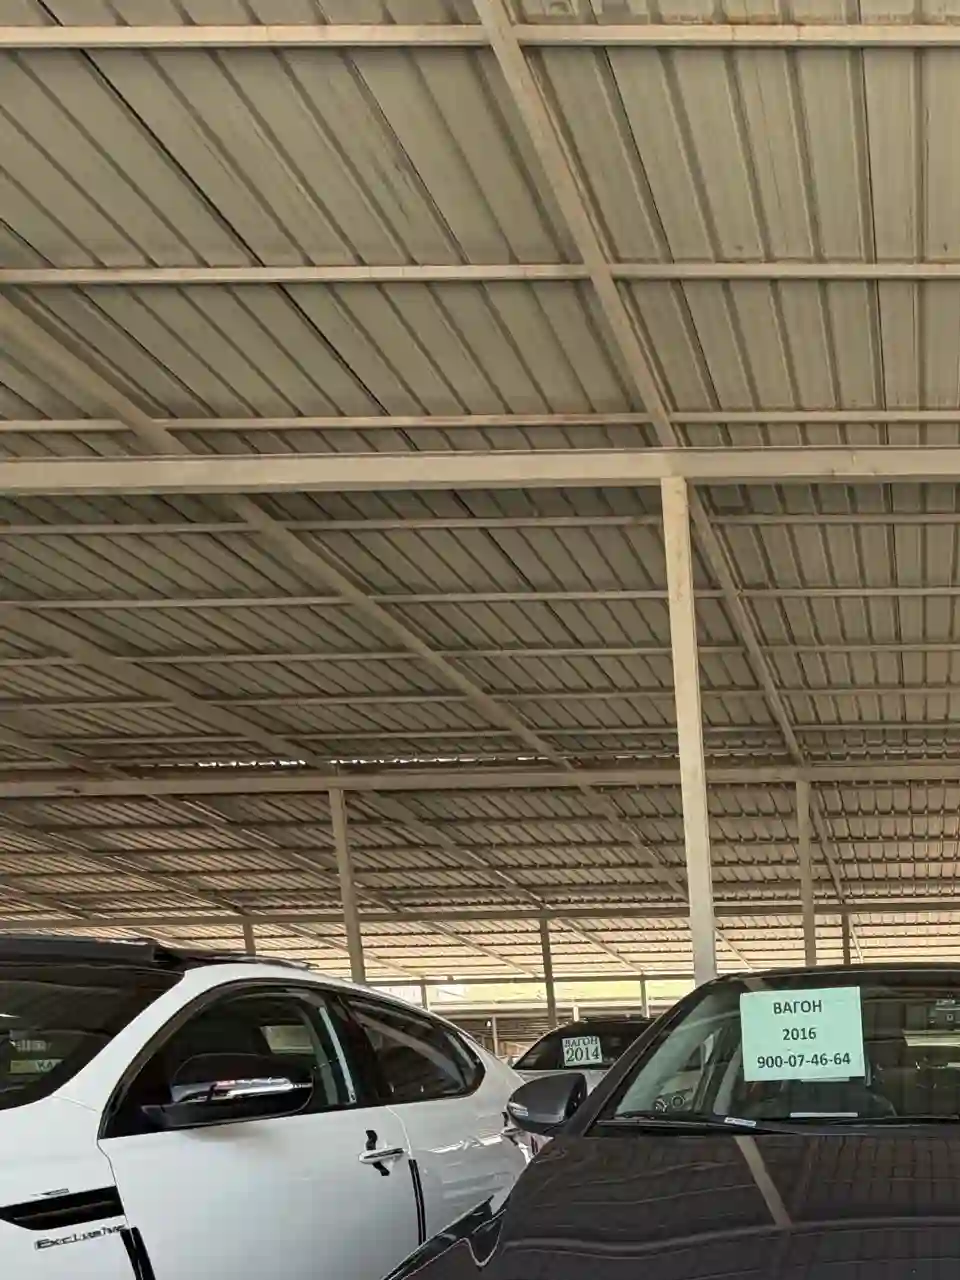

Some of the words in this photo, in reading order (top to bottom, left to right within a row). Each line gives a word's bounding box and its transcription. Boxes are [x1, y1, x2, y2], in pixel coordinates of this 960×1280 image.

[773, 1000, 822, 1015] ВАГОН
[782, 1027, 817, 1041] 2016
[566, 1047, 599, 1061] 2014
[757, 1052, 851, 1069] 900-07-46-64
